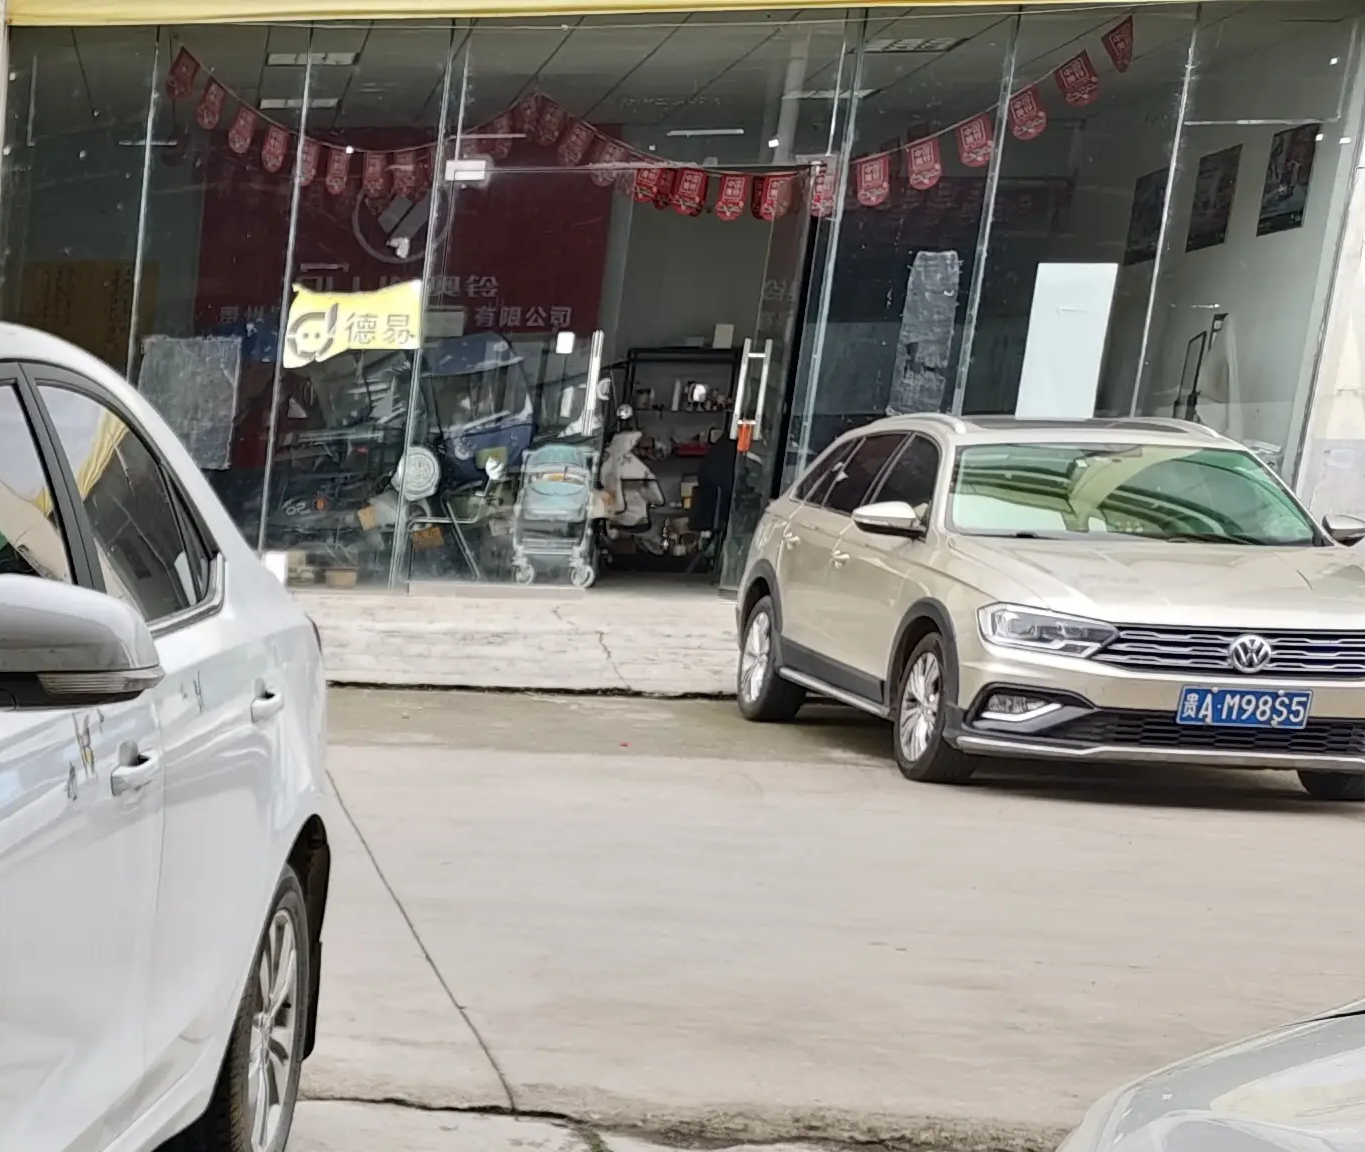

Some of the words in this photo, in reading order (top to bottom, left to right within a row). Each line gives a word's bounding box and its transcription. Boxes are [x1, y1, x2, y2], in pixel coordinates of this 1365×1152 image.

[345, 312, 416, 345] 德易
[474, 305, 573, 328] 有限公司
